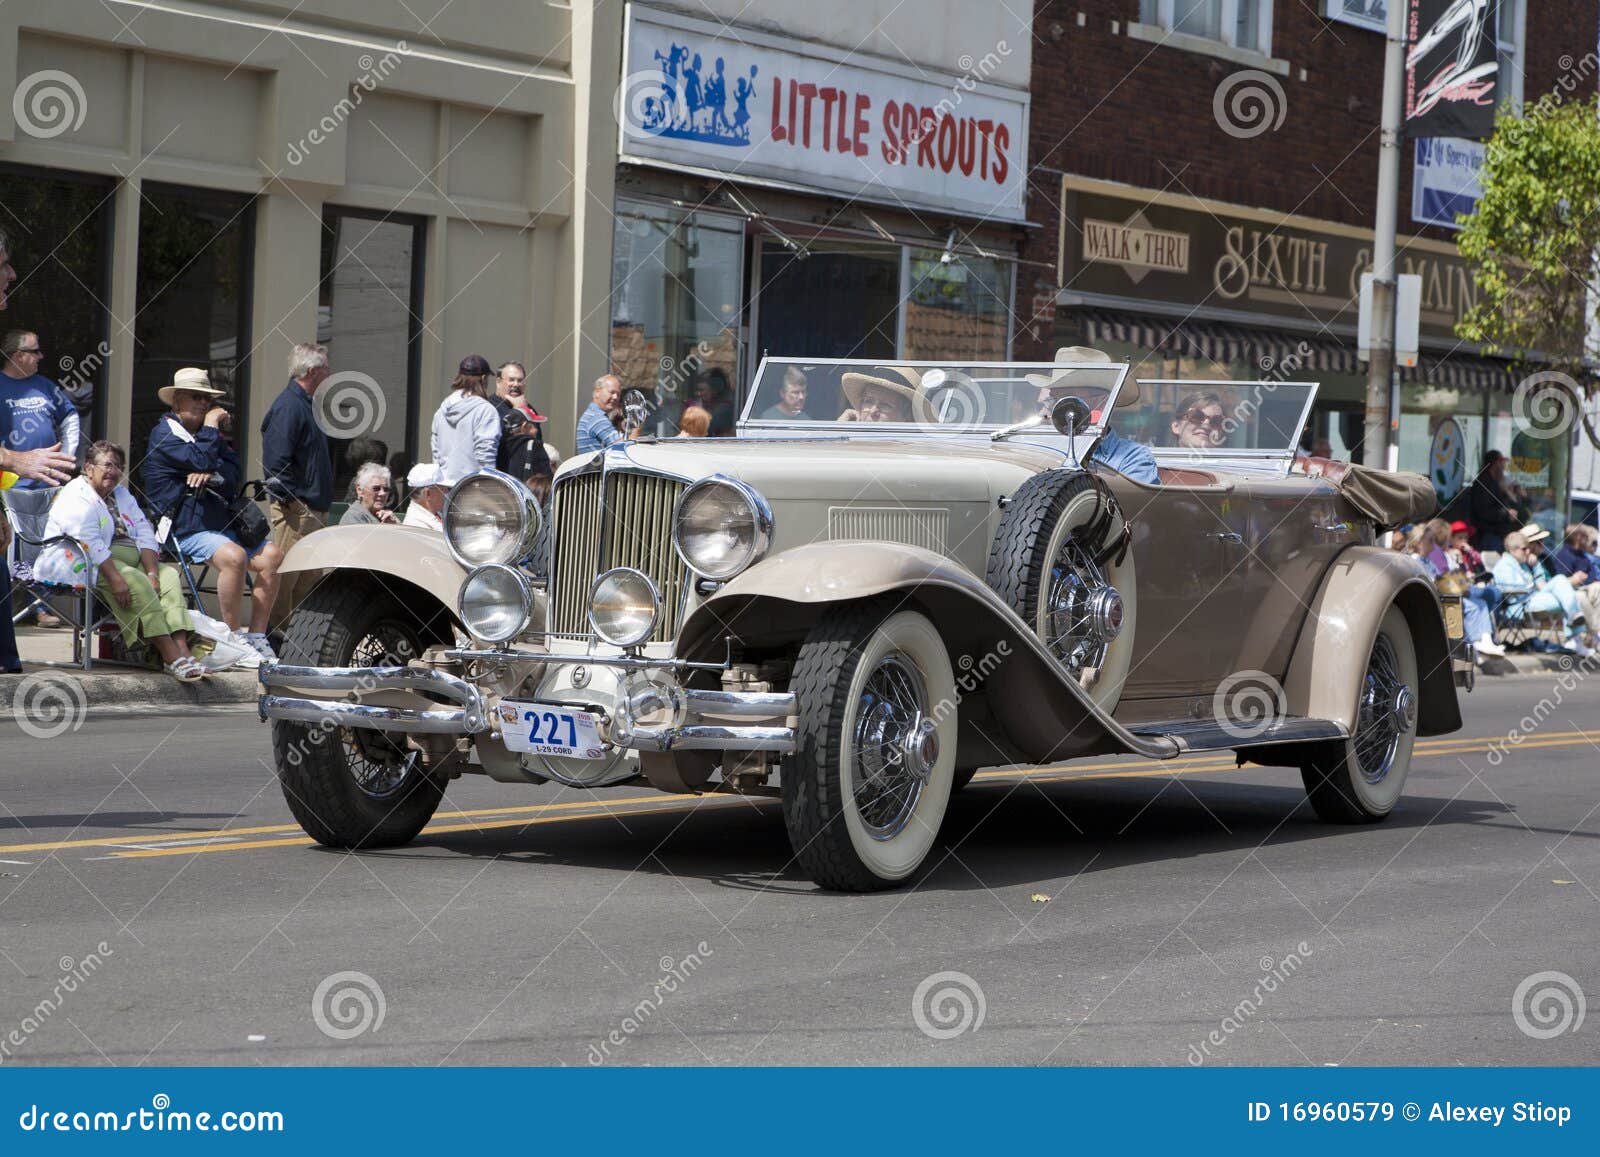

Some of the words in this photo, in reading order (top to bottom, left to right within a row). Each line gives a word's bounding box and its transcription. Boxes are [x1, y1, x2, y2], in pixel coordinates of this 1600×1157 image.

[771, 76, 871, 157] LITTLE
[881, 99, 1010, 185] SPROUTS
[1087, 224, 1131, 260] WALK
[1144, 232, 1187, 268] THRU
[1213, 226, 1328, 299] SIXTH
[524, 711, 577, 747] 227
[552, 746, 573, 755] CORD
